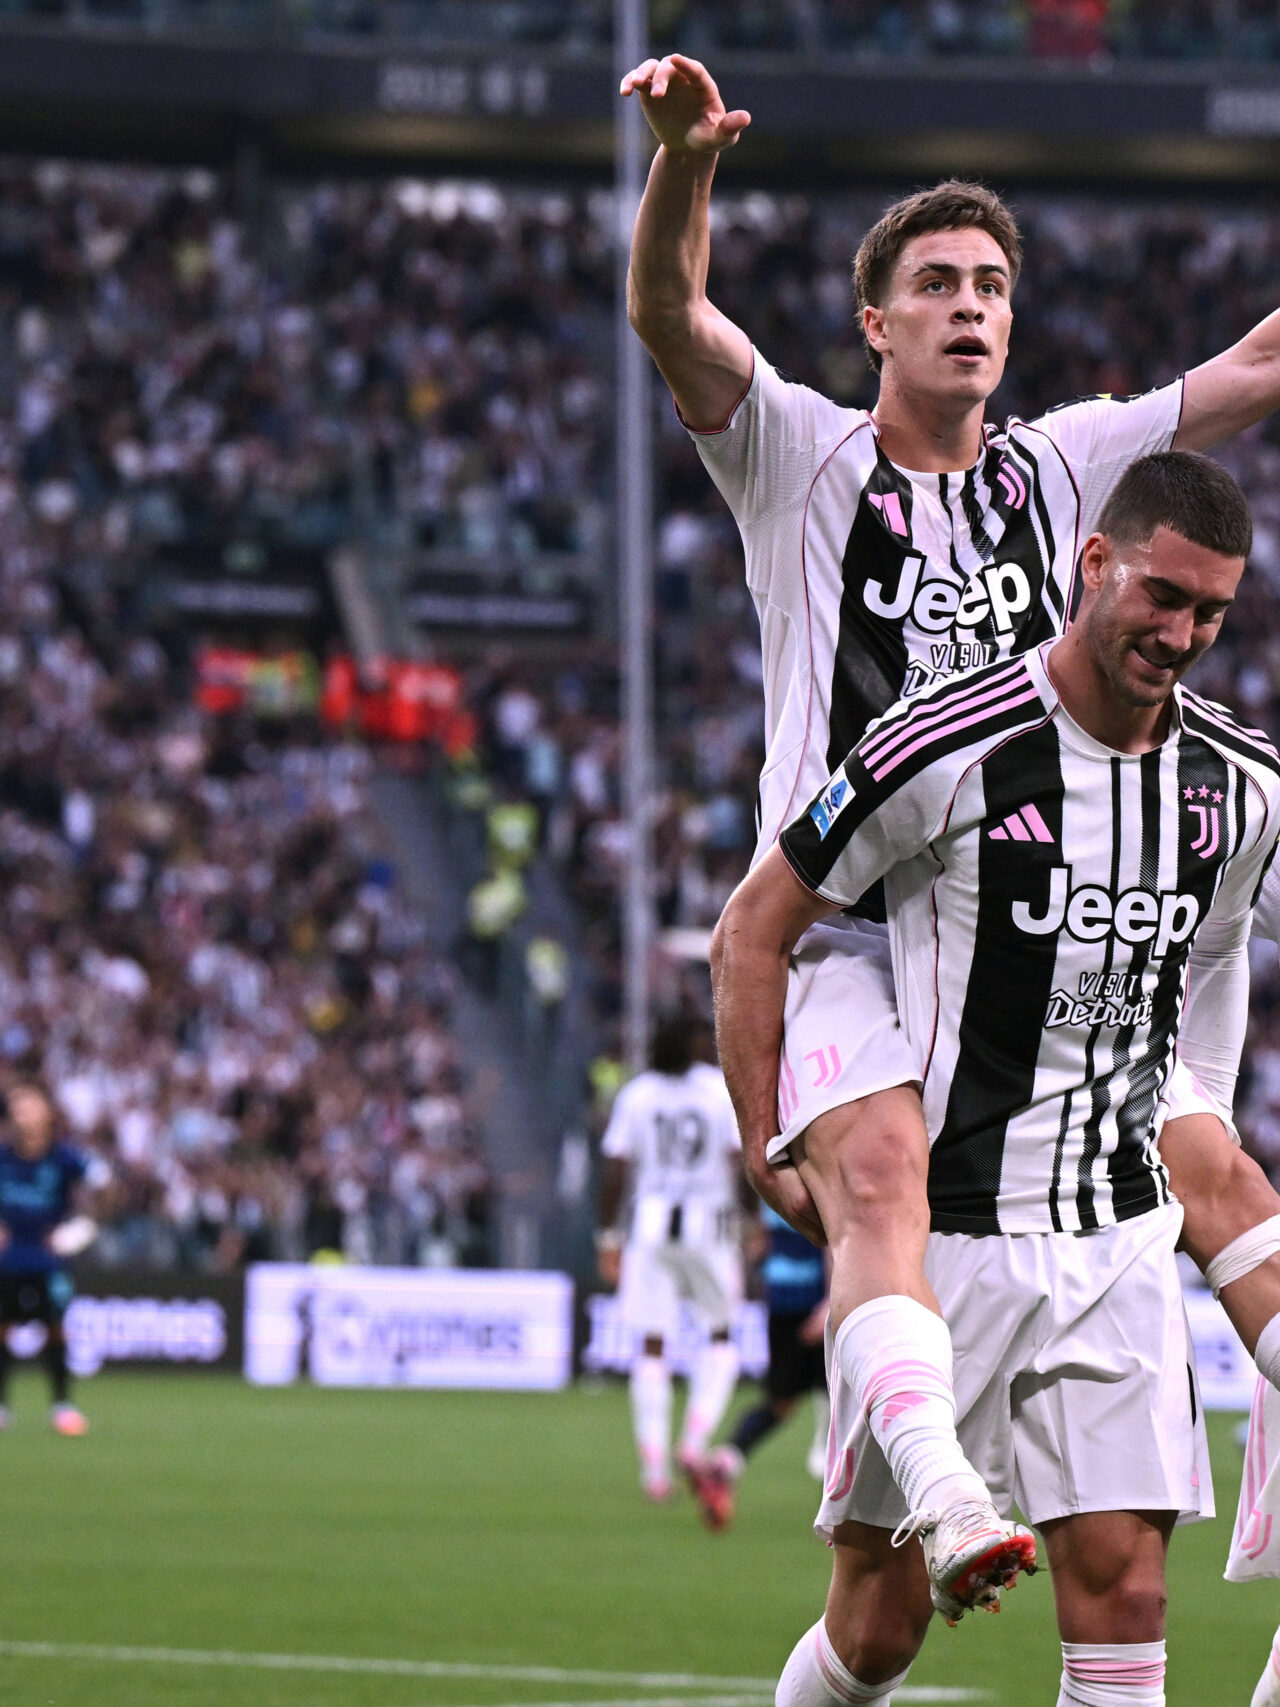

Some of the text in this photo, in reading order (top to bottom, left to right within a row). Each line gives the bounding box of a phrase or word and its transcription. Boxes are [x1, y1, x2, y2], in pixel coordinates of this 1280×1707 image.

[863, 556, 1031, 632] Jeep
[930, 643, 992, 669] VISIT
[1011, 867, 1200, 957] Jeep
[1044, 988, 1154, 1028] Detroit
[1078, 971, 1139, 998] VISIT
[654, 1110, 706, 1168] 19
